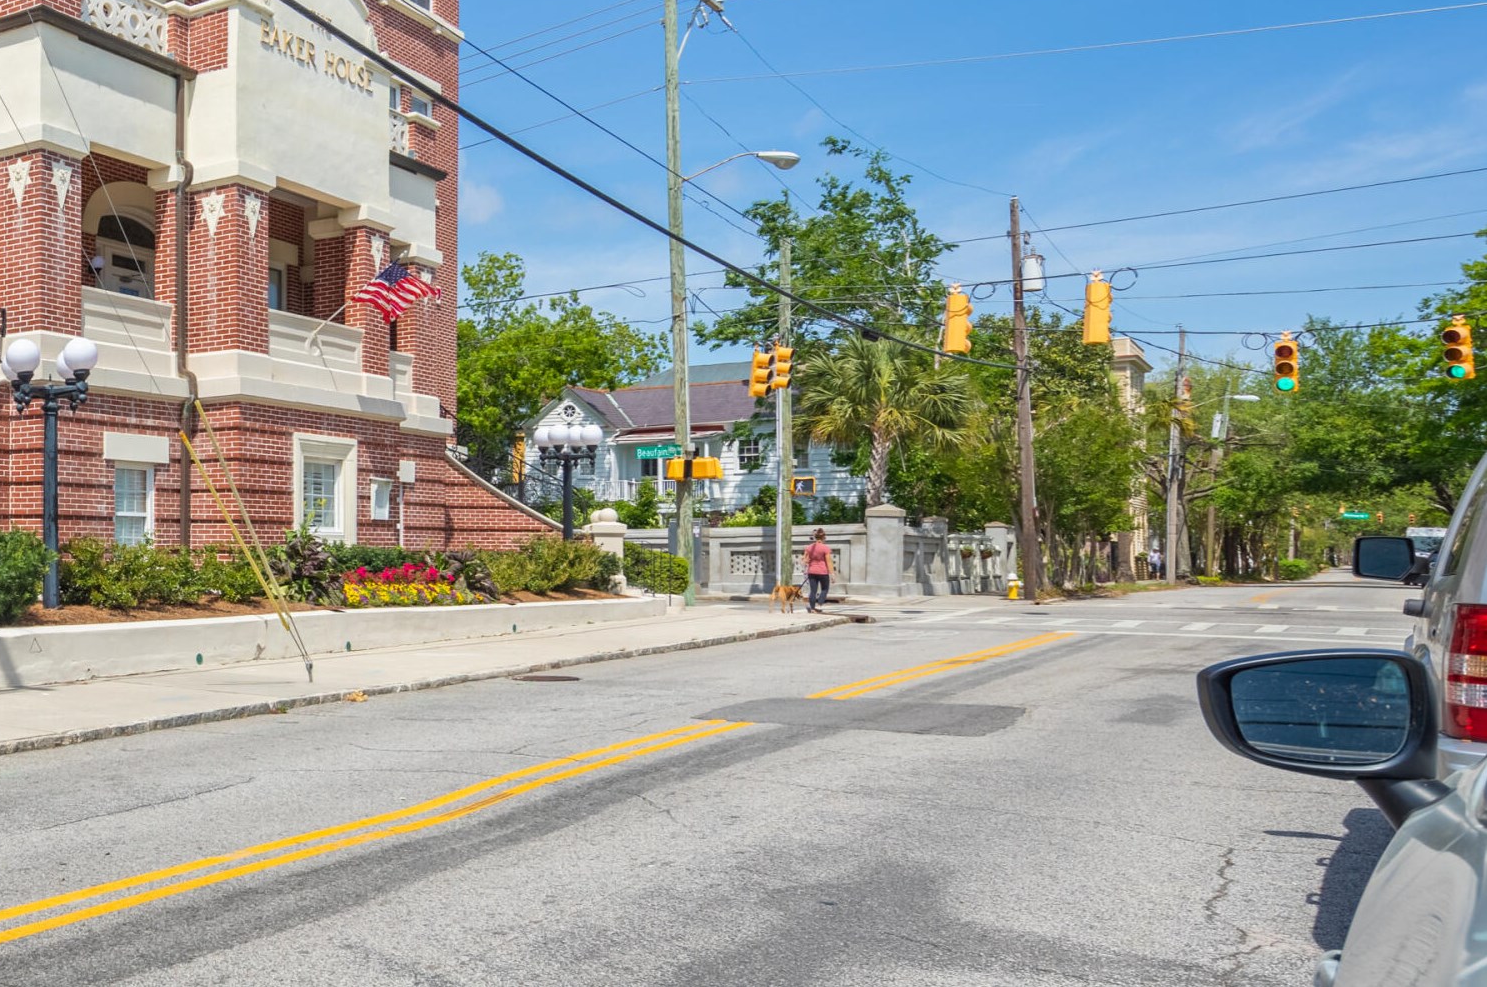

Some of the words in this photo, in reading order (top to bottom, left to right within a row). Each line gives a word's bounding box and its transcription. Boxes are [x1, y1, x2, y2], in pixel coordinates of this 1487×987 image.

[260, 18, 317, 67] BAKER
[324, 49, 374, 93] HOUSE
[637, 447, 668, 458] Beaufain
